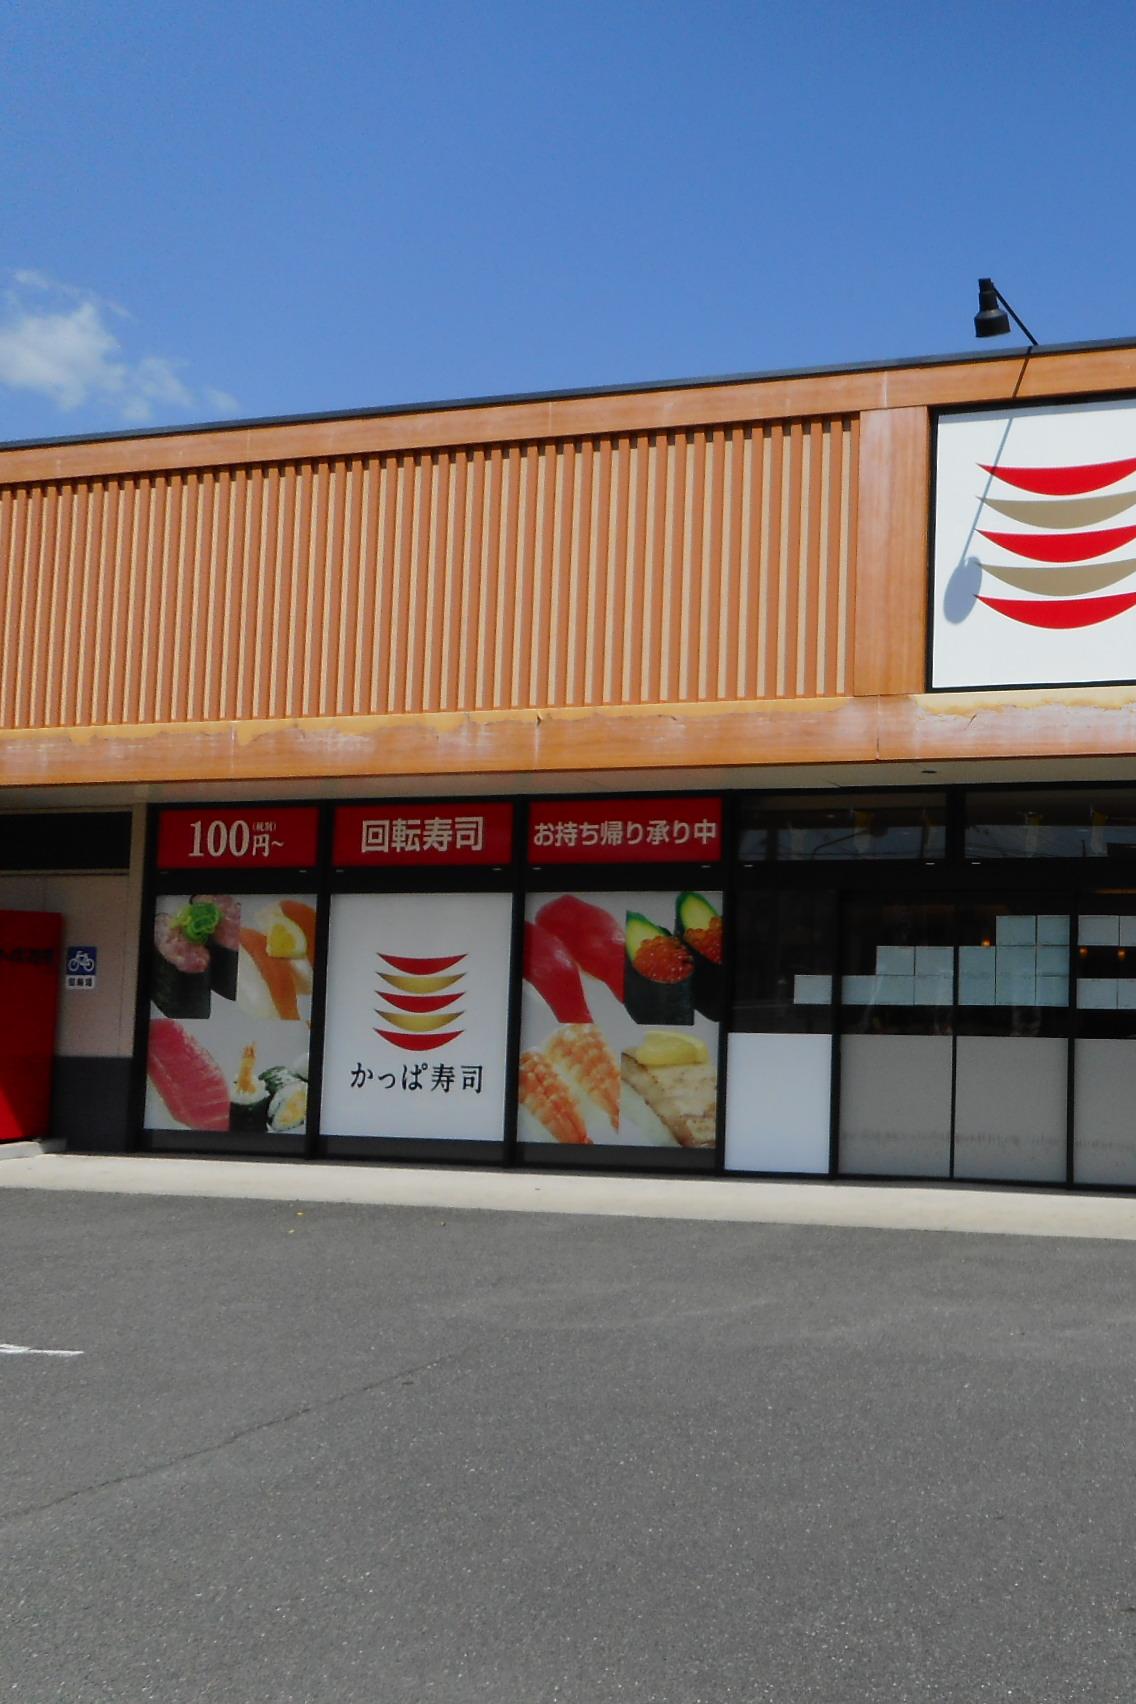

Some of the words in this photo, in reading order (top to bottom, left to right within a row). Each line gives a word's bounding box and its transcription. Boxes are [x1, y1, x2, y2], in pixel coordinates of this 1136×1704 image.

[361, 816, 485, 854] 回転寿司
[533, 818, 718, 847] お持ち帰り承り中
[349, 1062, 485, 1094] かっぱ寿司
